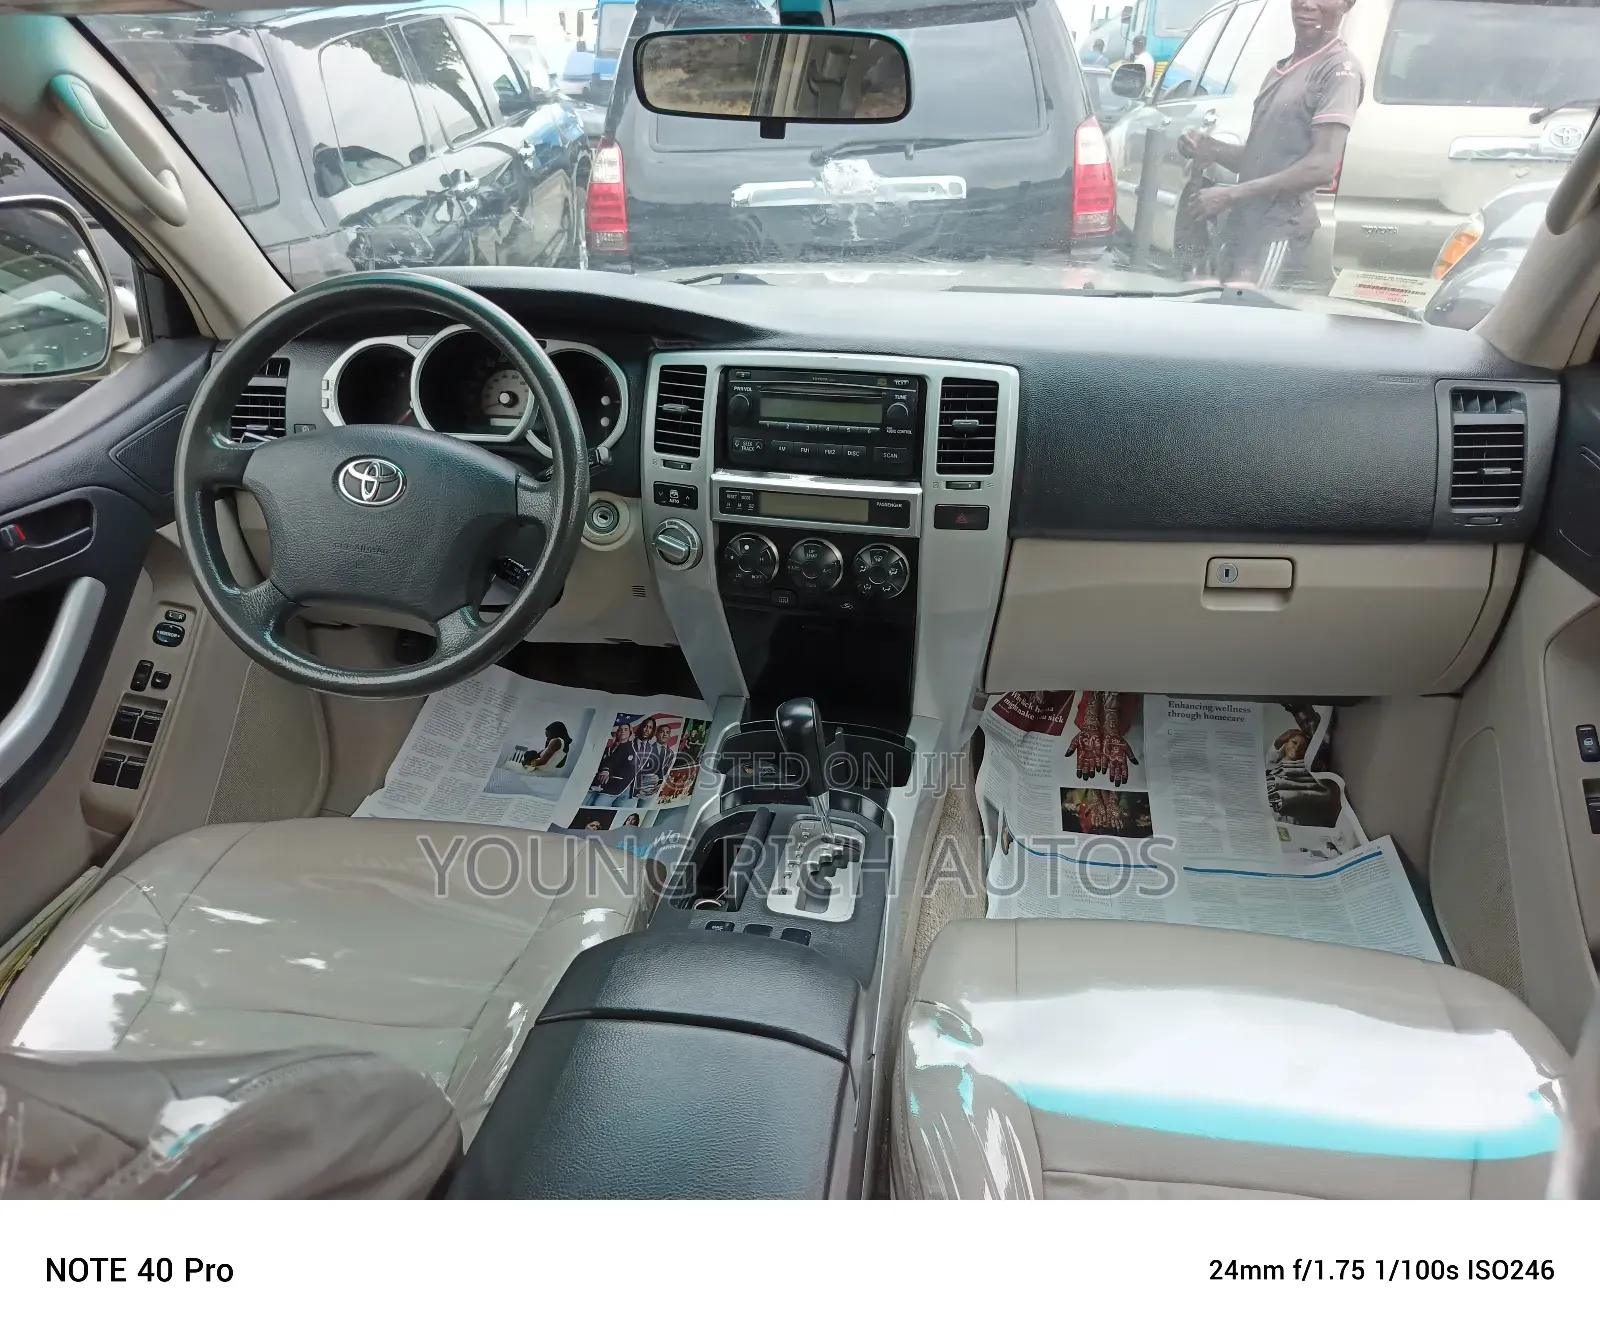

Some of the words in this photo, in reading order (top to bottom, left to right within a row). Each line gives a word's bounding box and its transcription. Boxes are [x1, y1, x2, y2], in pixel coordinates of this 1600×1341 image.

[1168, 701, 1213, 713] Enhancing
[1215, 705, 1251, 713] wellness
[1048, 714, 1064, 723] sick
[1168, 710, 1202, 721] through
[1204, 712, 1245, 722] homecare
